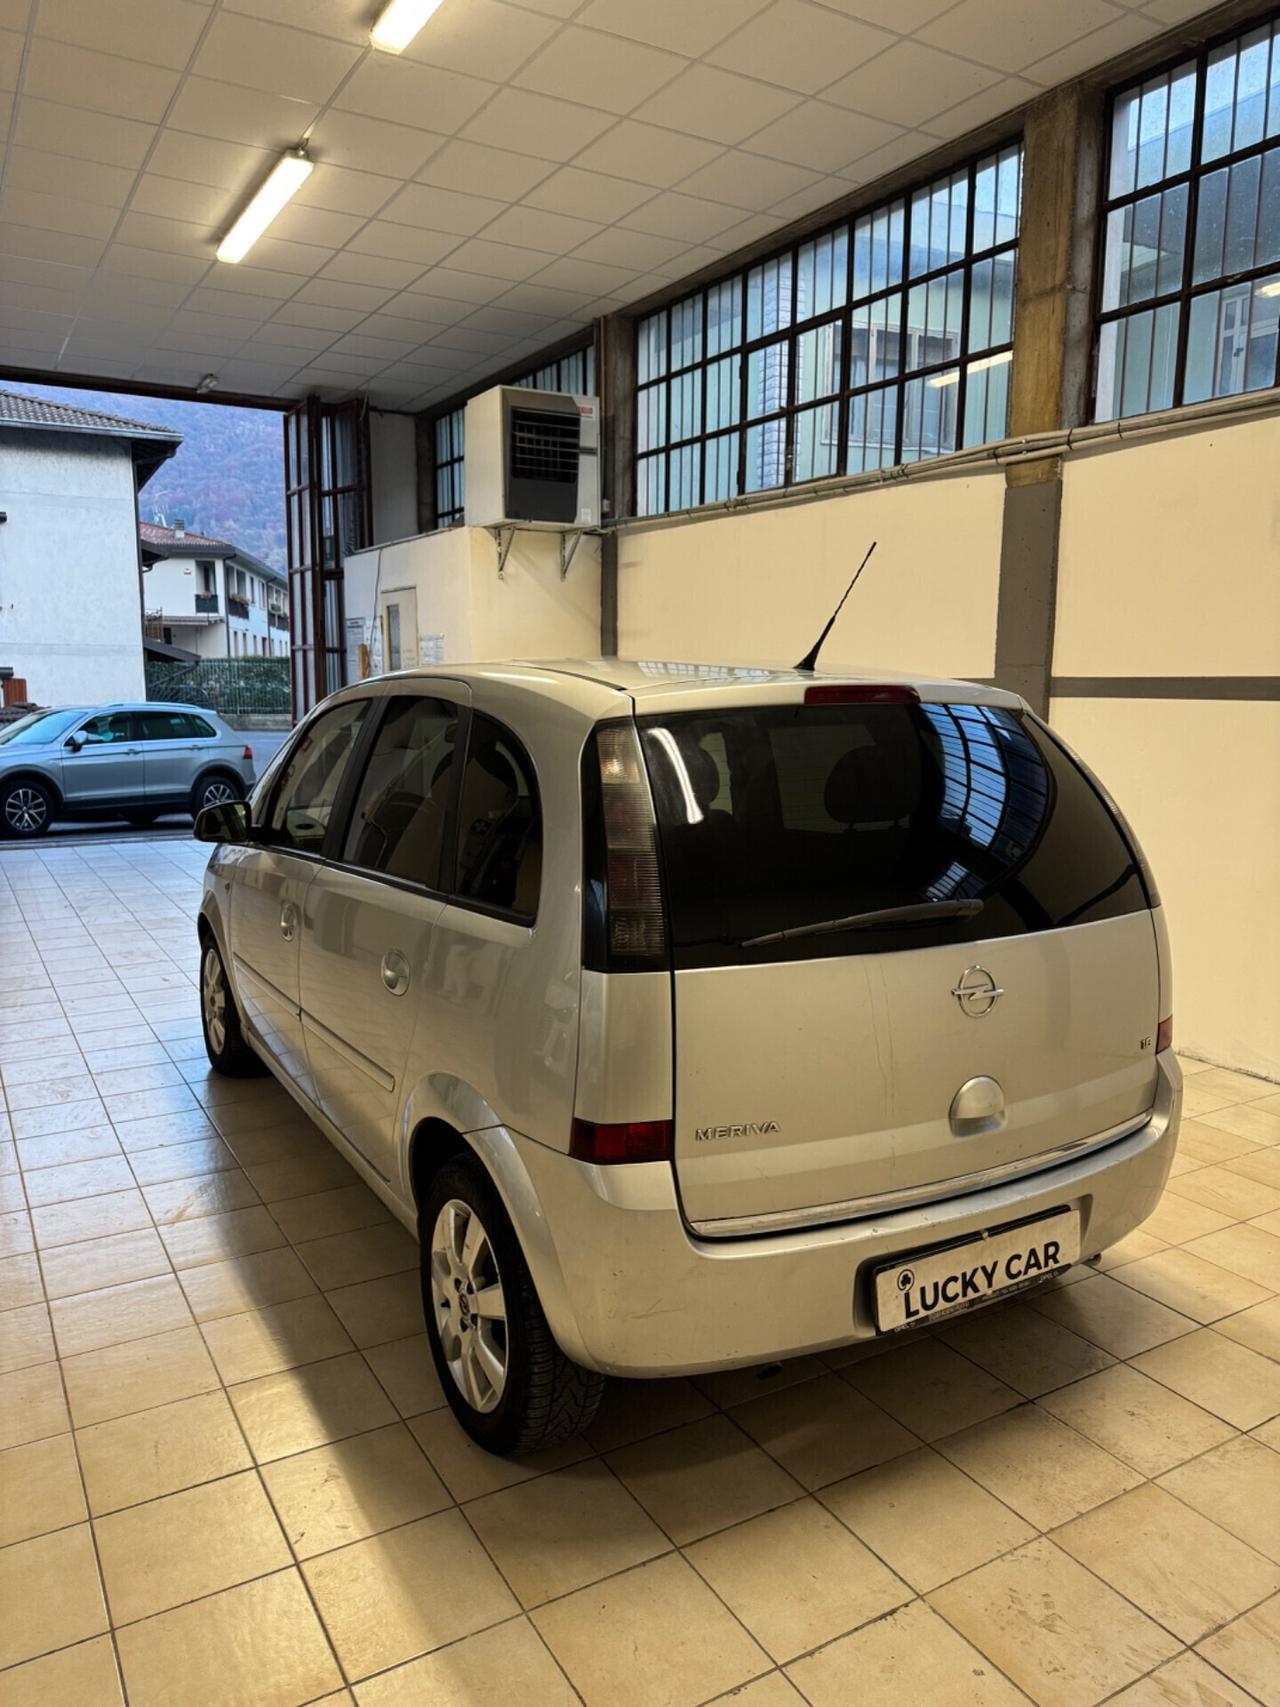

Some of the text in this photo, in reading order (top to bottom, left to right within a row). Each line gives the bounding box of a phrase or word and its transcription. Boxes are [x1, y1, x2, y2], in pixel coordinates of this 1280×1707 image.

[695, 1121, 780, 1141] MERIVA
[904, 1261, 998, 1319] LUCKY
[1005, 1241, 1060, 1280] CAR
